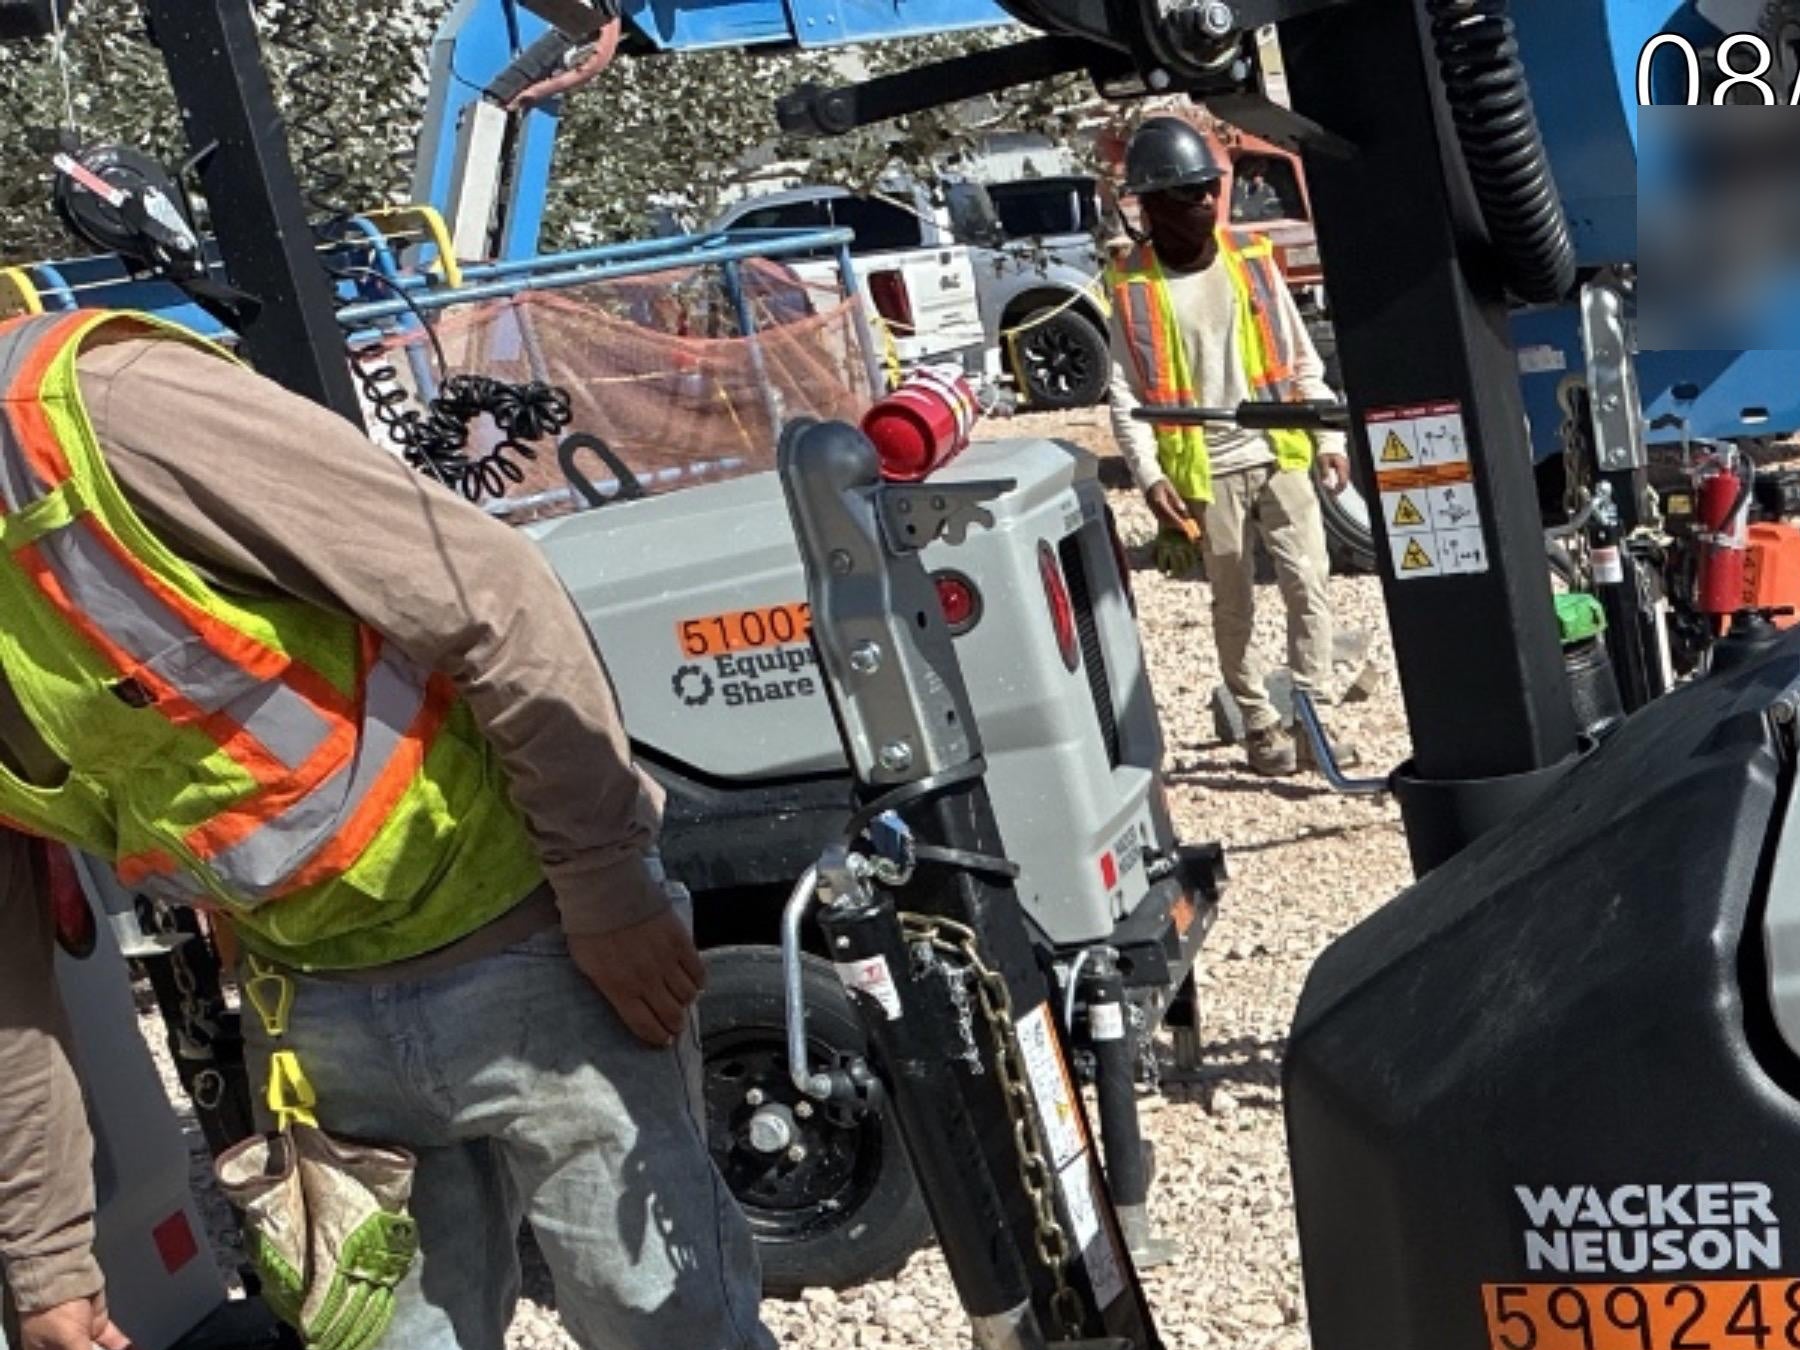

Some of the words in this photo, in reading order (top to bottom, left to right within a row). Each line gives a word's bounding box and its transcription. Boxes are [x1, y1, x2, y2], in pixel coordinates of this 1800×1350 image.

[722, 676, 815, 706] Share
[1514, 1181, 1779, 1228] WACKER
[1524, 1226, 1782, 1273] NEUSON
